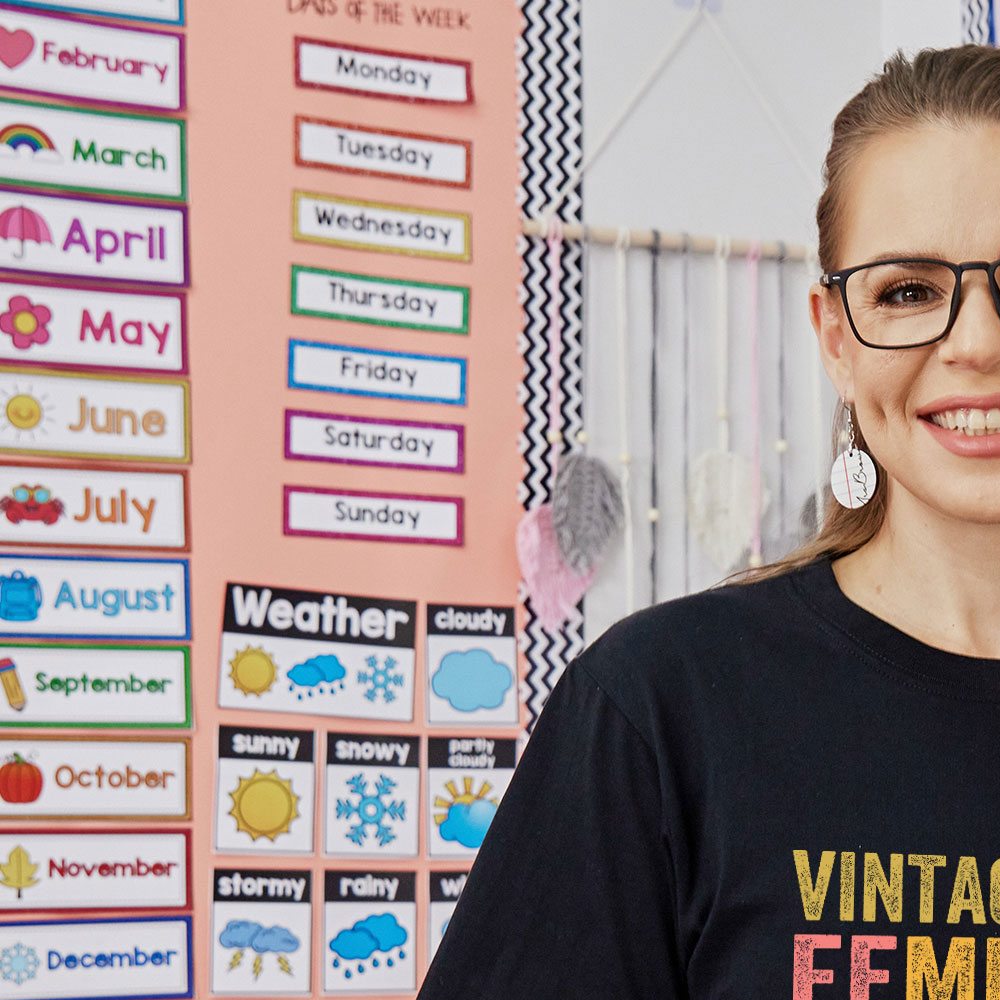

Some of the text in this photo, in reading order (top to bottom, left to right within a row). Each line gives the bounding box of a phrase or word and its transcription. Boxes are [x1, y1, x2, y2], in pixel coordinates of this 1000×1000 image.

[373, 3, 403, 25] THE
[412, 6, 471, 30] WEEK
[42, 41, 168, 84] February
[336, 55, 432, 91] Monday
[72, 139, 167, 171] March
[336, 133, 434, 171] Tuesday
[62, 218, 166, 263] April
[314, 207, 453, 247] Wednesday
[328, 282, 439, 318] Thursday
[79, 309, 171, 355] May
[340, 357, 418, 387] Friday
[69, 398, 166, 436] June
[324, 426, 435, 457] Saturday
[74, 488, 155, 533] July
[335, 501, 421, 529] Sunday
[55, 581, 175, 617] August
[232, 586, 410, 641] Weather
[434, 607, 507, 636] cloudy
[35, 672, 172, 696] September
[232, 734, 300, 760] sunny
[335, 739, 410, 765] snowy
[447, 752, 497, 769] cloudy
[449, 737, 495, 754] partly
[55, 765, 175, 789] October
[48, 858, 178, 878] November
[218, 872, 306, 901] stormy
[339, 873, 399, 901] rainy
[47, 946, 178, 970] December
